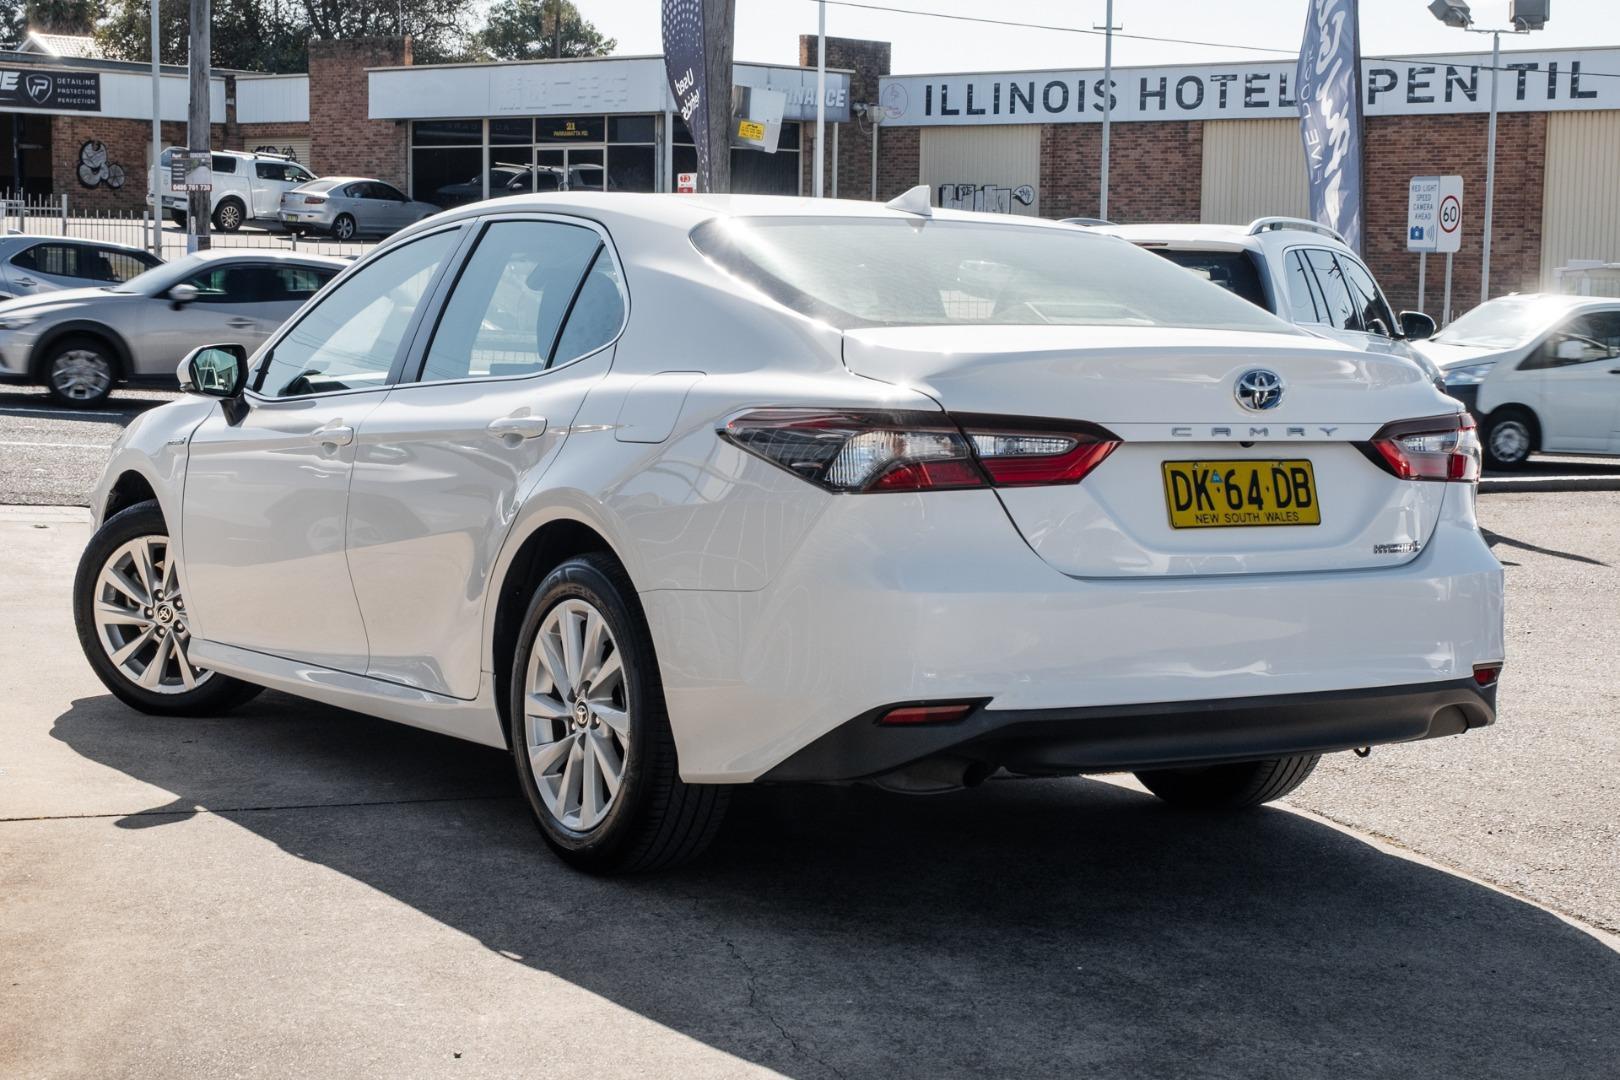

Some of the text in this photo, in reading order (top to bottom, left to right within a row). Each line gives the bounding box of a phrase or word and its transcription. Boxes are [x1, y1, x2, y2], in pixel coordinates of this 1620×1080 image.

[57, 77, 96, 86] DETAILING
[925, 61, 1597, 116] ILLINOIS HOTEL PEN TIL
[1423, 184, 1437, 192] LIGHT
[1416, 194, 1432, 202] SPEED
[1443, 206, 1457, 222] 60
[1171, 427, 1338, 437] CAMRY
[1195, 511, 1299, 524] NEW SOUTH WALES
